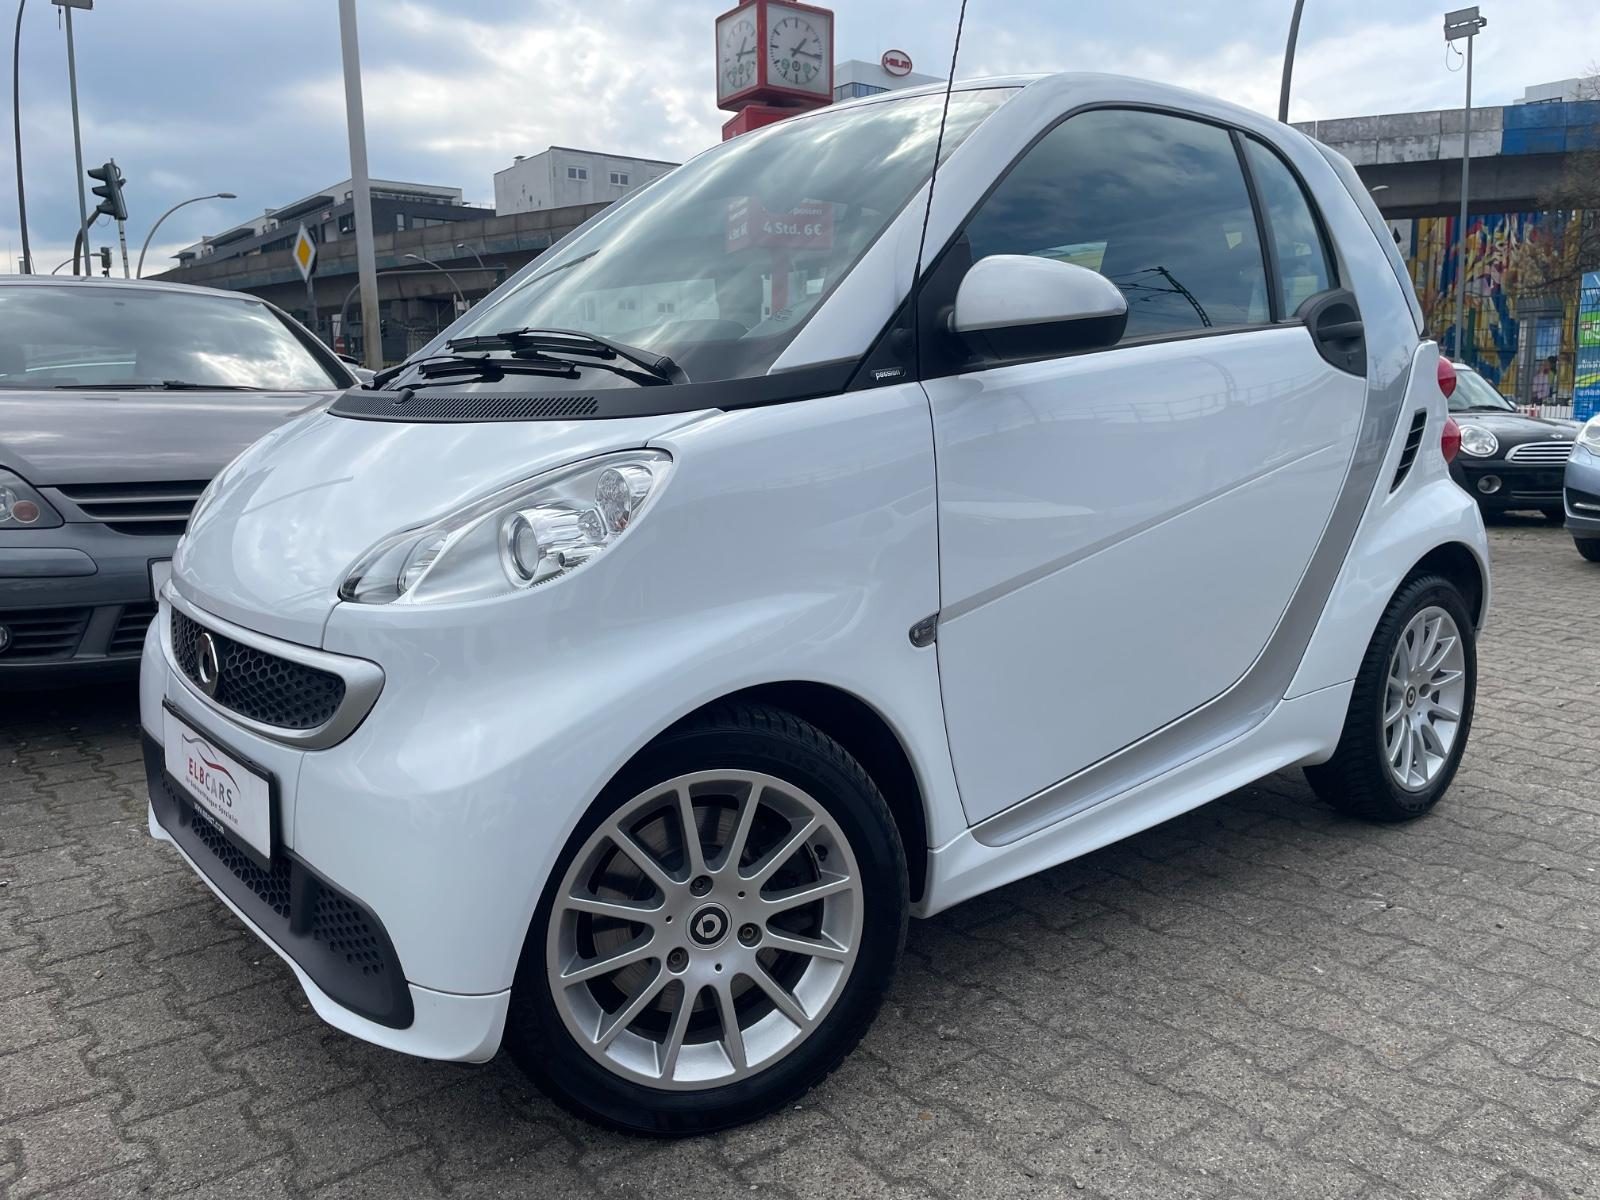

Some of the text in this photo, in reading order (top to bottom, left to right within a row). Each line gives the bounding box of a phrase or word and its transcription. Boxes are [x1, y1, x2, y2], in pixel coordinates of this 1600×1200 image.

[885, 56, 910, 70] HELM
[763, 220, 773, 234] 4
[775, 222, 801, 236] Std.
[188, 757, 233, 808] ELBCARS
